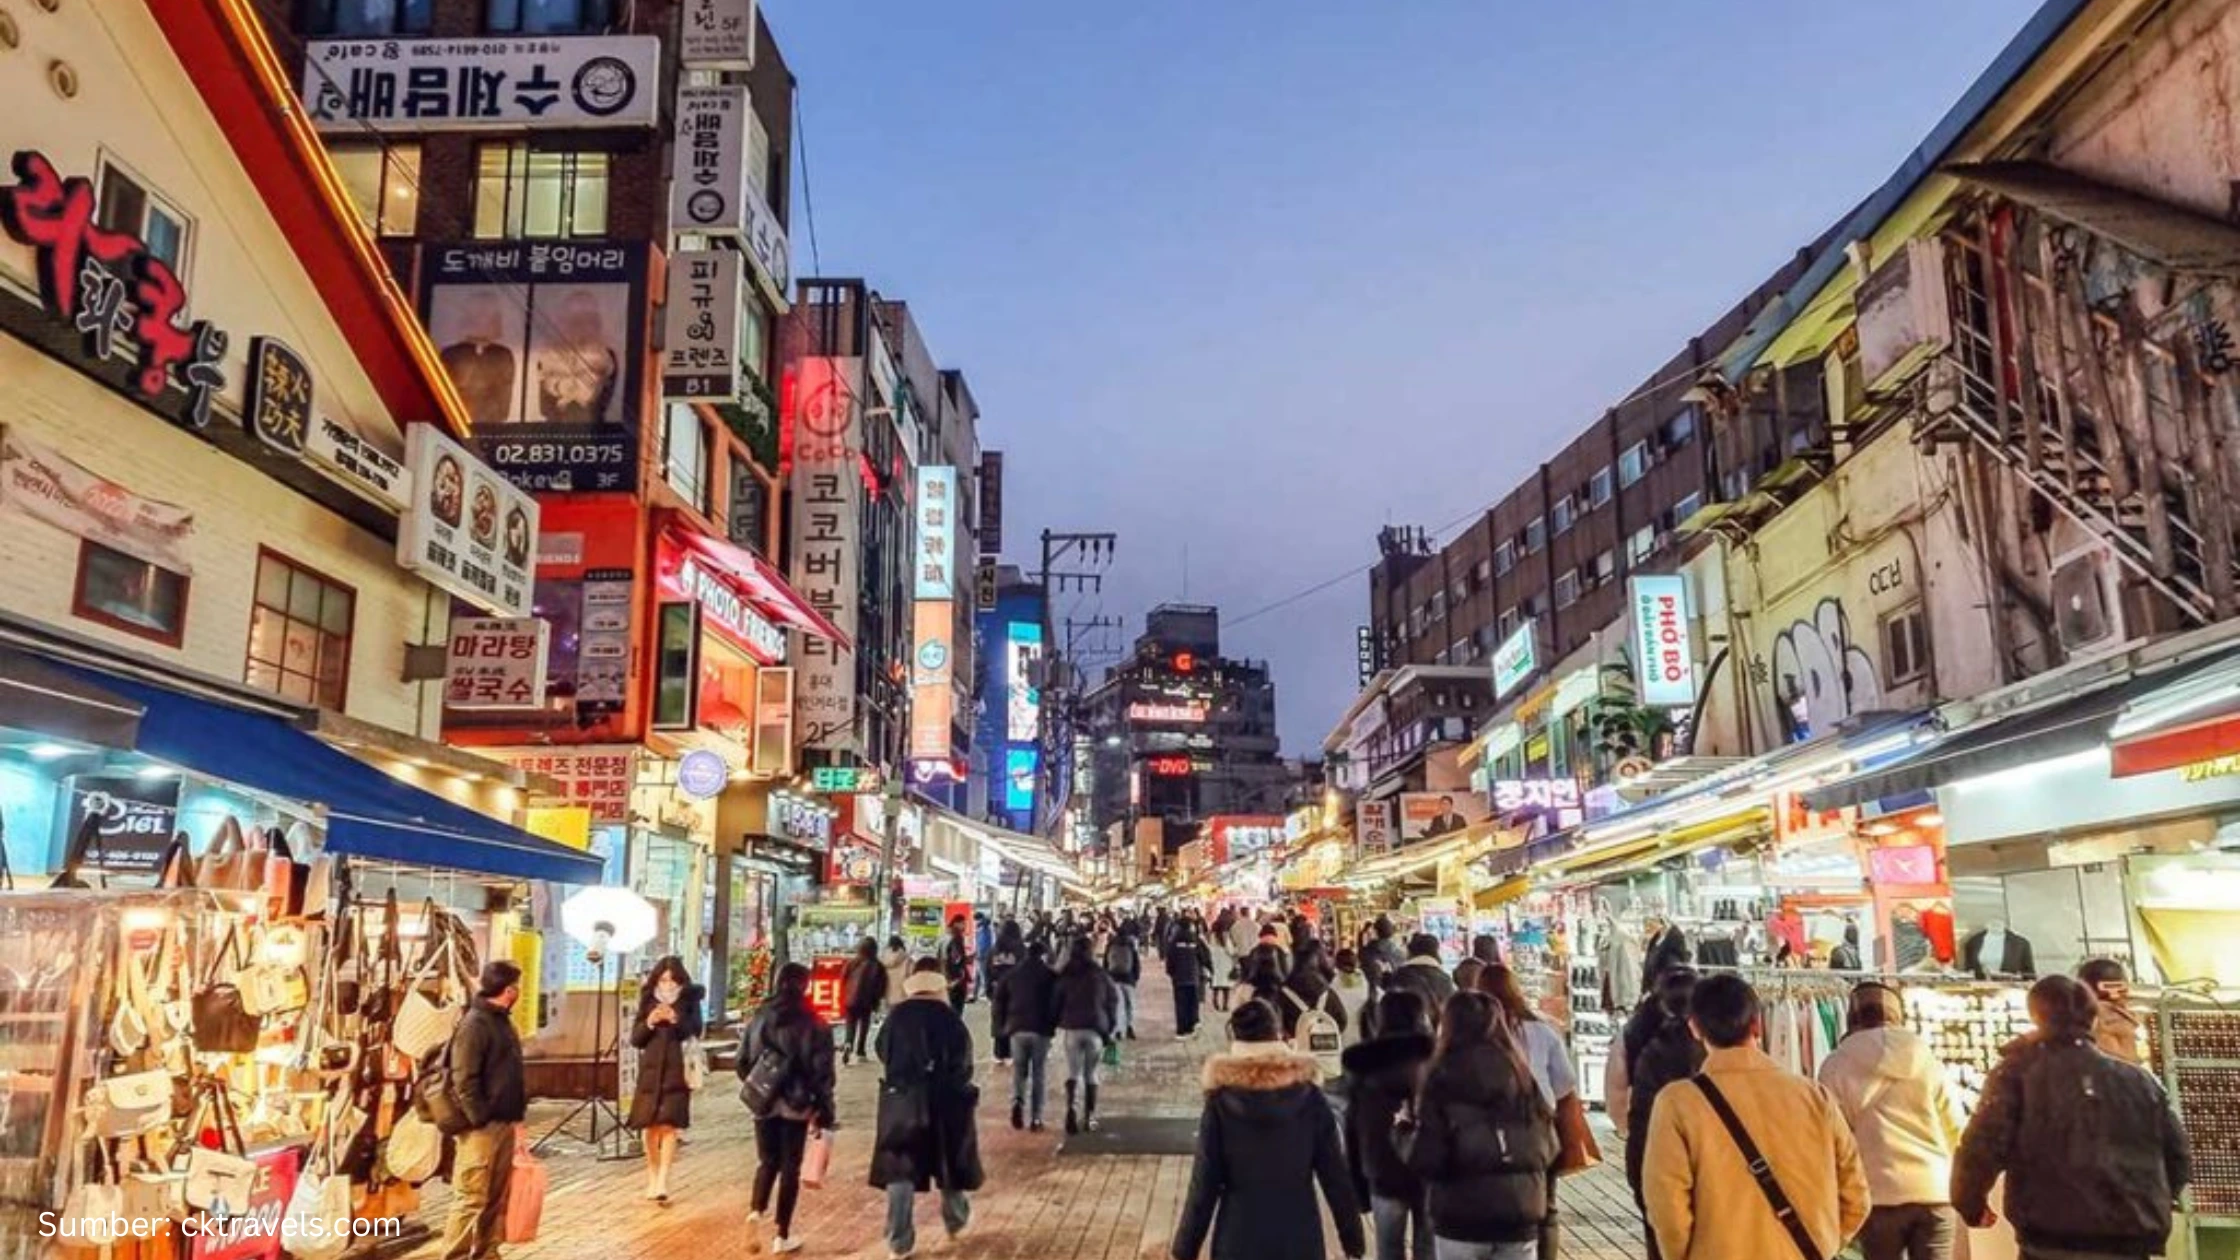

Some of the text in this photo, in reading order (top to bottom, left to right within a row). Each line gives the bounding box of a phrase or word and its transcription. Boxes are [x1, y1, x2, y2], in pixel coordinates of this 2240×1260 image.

[347, 65, 561, 118] 수제담배
[441, 250, 520, 272] 도깨비
[669, 348, 730, 369] 프렌즈
[453, 635, 537, 660] 마라탕
[451, 676, 532, 702] 쌀국수
[1157, 758, 1191, 775] DVD
